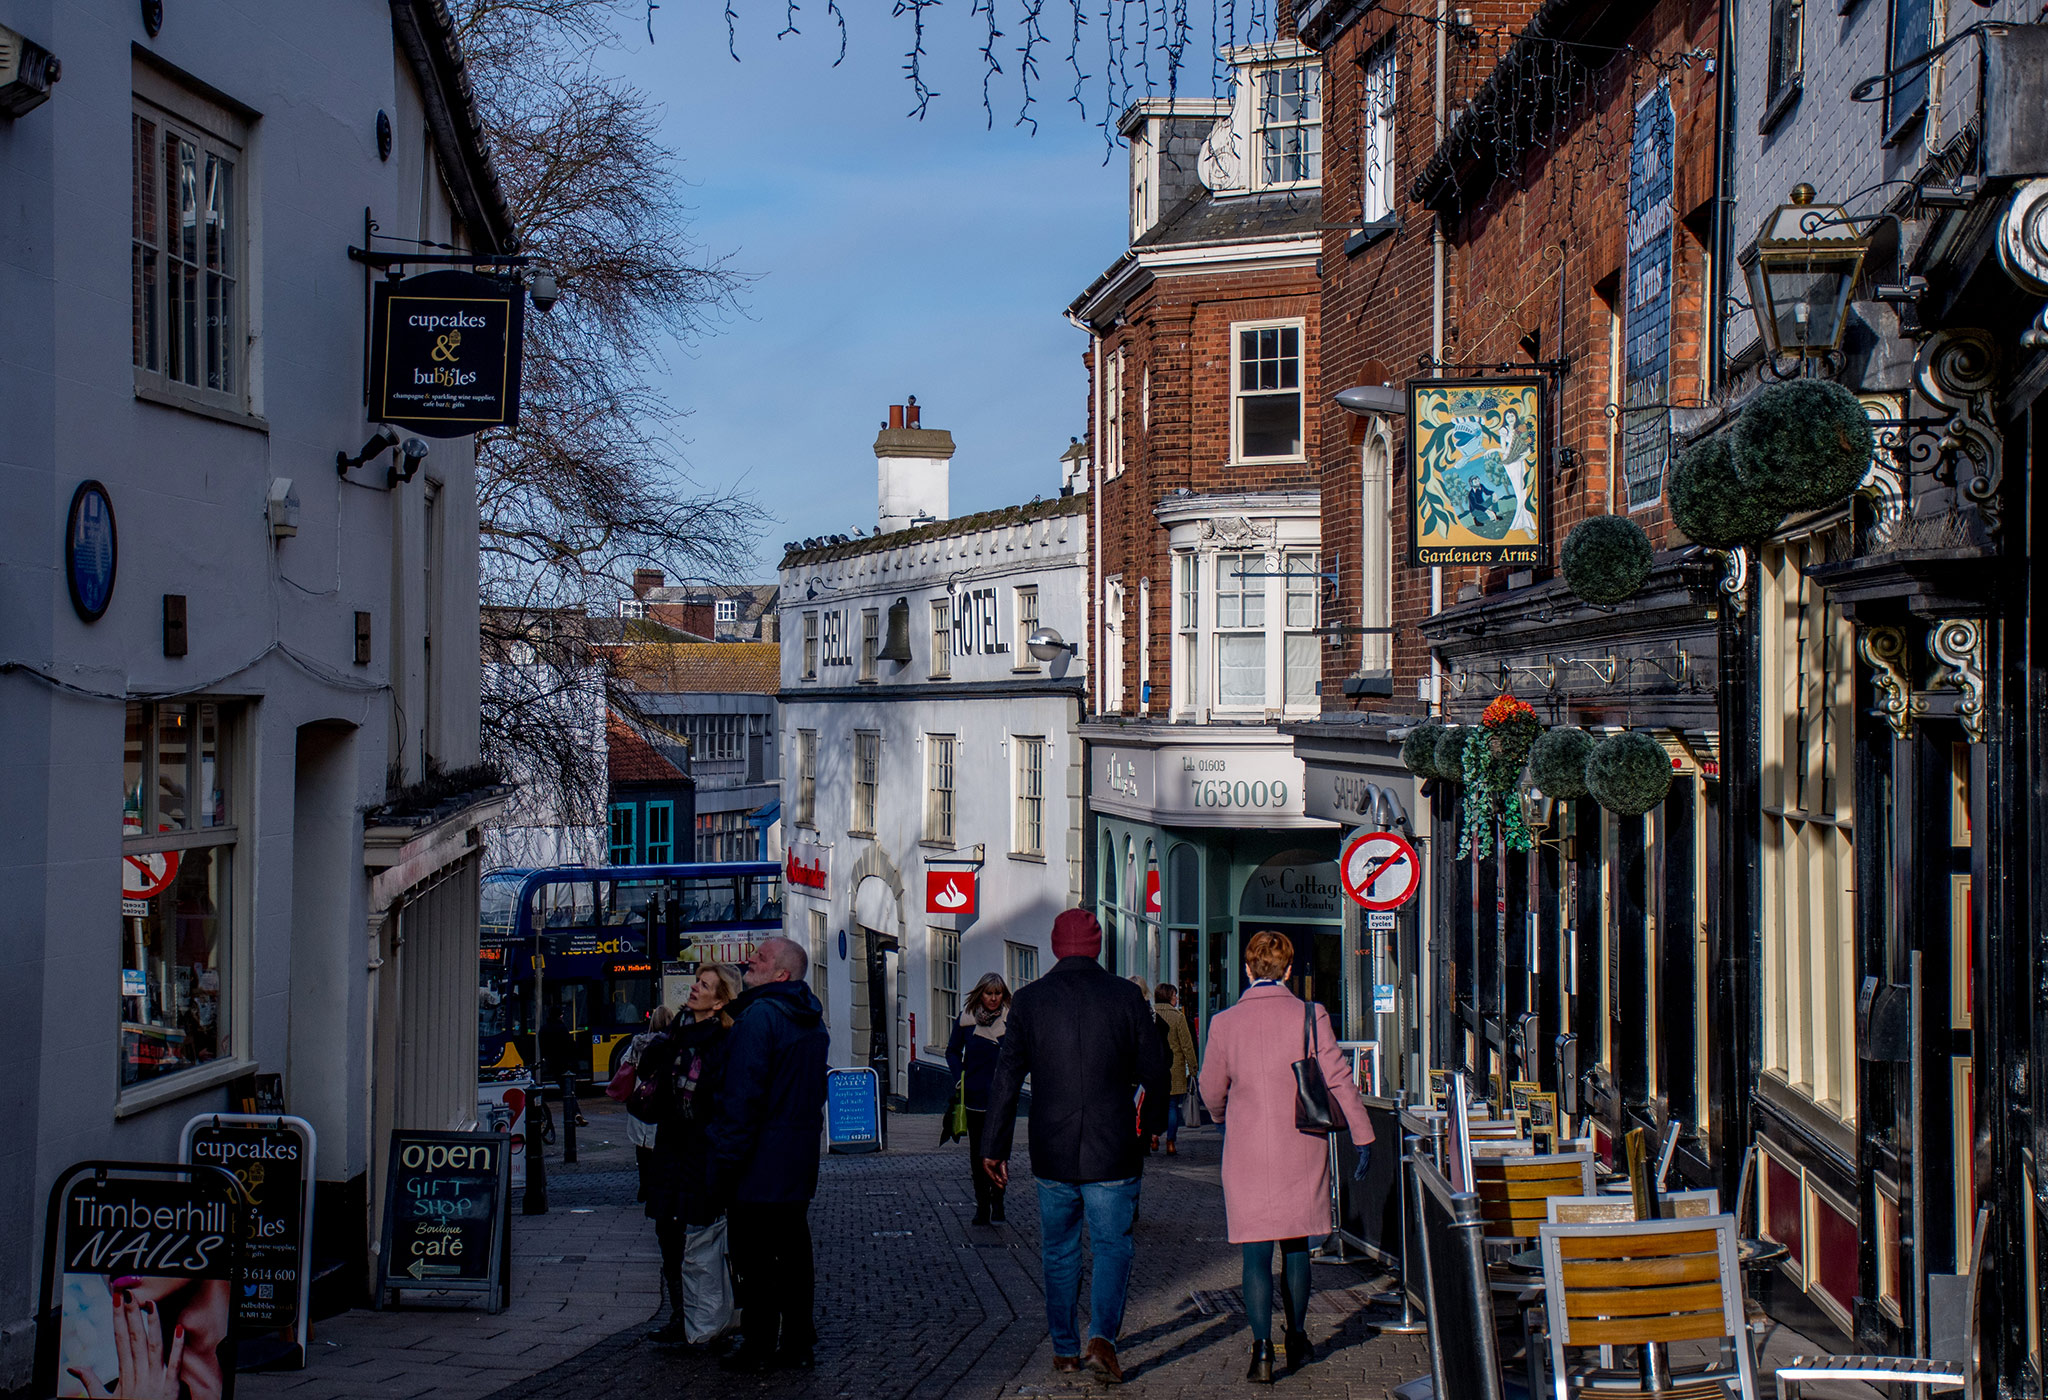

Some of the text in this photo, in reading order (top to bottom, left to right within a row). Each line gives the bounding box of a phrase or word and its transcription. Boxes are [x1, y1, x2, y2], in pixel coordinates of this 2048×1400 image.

[1628, 194, 1672, 252] Gardeners
[1634, 262, 1662, 309] Arms
[408, 310, 486, 332] cupcakes
[431, 334, 460, 362] &
[1637, 326, 1658, 367] FREE
[414, 367, 477, 387] bubbles
[393, 392, 424, 401] champagne
[432, 393, 457, 401] sparkling
[1632, 370, 1660, 411] HOUSE
[1419, 547, 1538, 564] Gardeners Arms
[822, 608, 853, 667] BELL
[1198, 759, 1226, 772] 01603
[1191, 779, 1288, 809] 763009
[1333, 775, 1369, 812] SAHAR
[1259, 875, 1277, 889] The
[1266, 894, 1289, 909] Hair
[1300, 896, 1334, 911] Beauty
[1370, 914, 1393, 922] Except
[1371, 920, 1392, 928] cycles
[694, 943, 755, 963] TULIP
[195, 1137, 297, 1164] cupcakes
[402, 1145, 491, 1173] open
[407, 1177, 472, 1199] GIFT
[75, 1196, 226, 1233] Timberhill
[413, 1198, 472, 1216] SHOP
[415, 1222, 463, 1236] Boutique
[71, 1229, 224, 1271] NAILS
[411, 1235, 463, 1257] café
[251, 1267, 272, 1281] 614
[275, 1268, 296, 1281] 600
